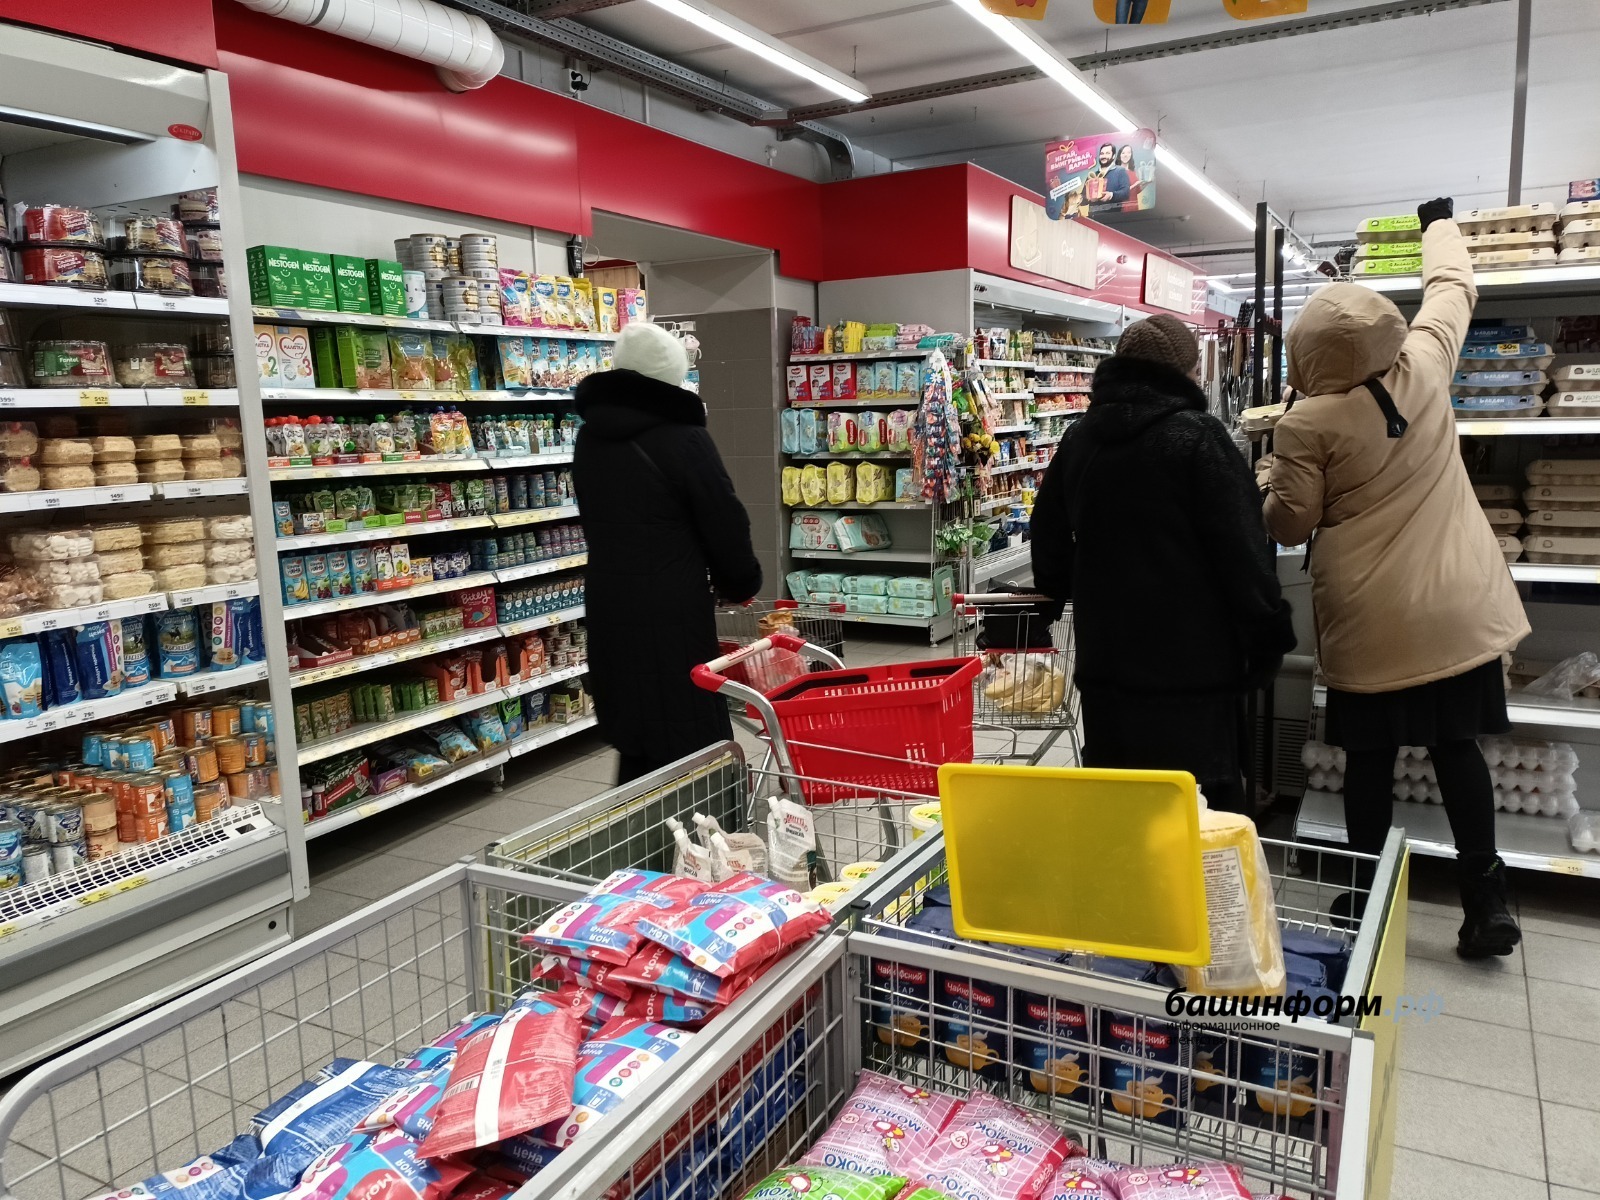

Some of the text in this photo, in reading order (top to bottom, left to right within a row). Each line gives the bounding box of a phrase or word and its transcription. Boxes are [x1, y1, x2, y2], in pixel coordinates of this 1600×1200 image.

[1050, 151, 1093, 170] ВЫИГРЫВАЙ,
[1054, 150, 1078, 162] ИГРАЙ,
[1068, 159, 1089, 171] ДАРИ!
[268, 258, 331, 274] NESTOGEN NESTOGEN
[337, 267, 365, 279] NESTOGEN
[293, 276, 330, 289] 1 1
[381, 271, 402, 283] NESTOGEN
[268, 356, 312, 376] 2 3
[461, 589, 491, 604] Bitey
[589, 933, 610, 944] моя
[854, 1102, 921, 1133] МОЛОКО
[513, 1147, 543, 1164] цена
